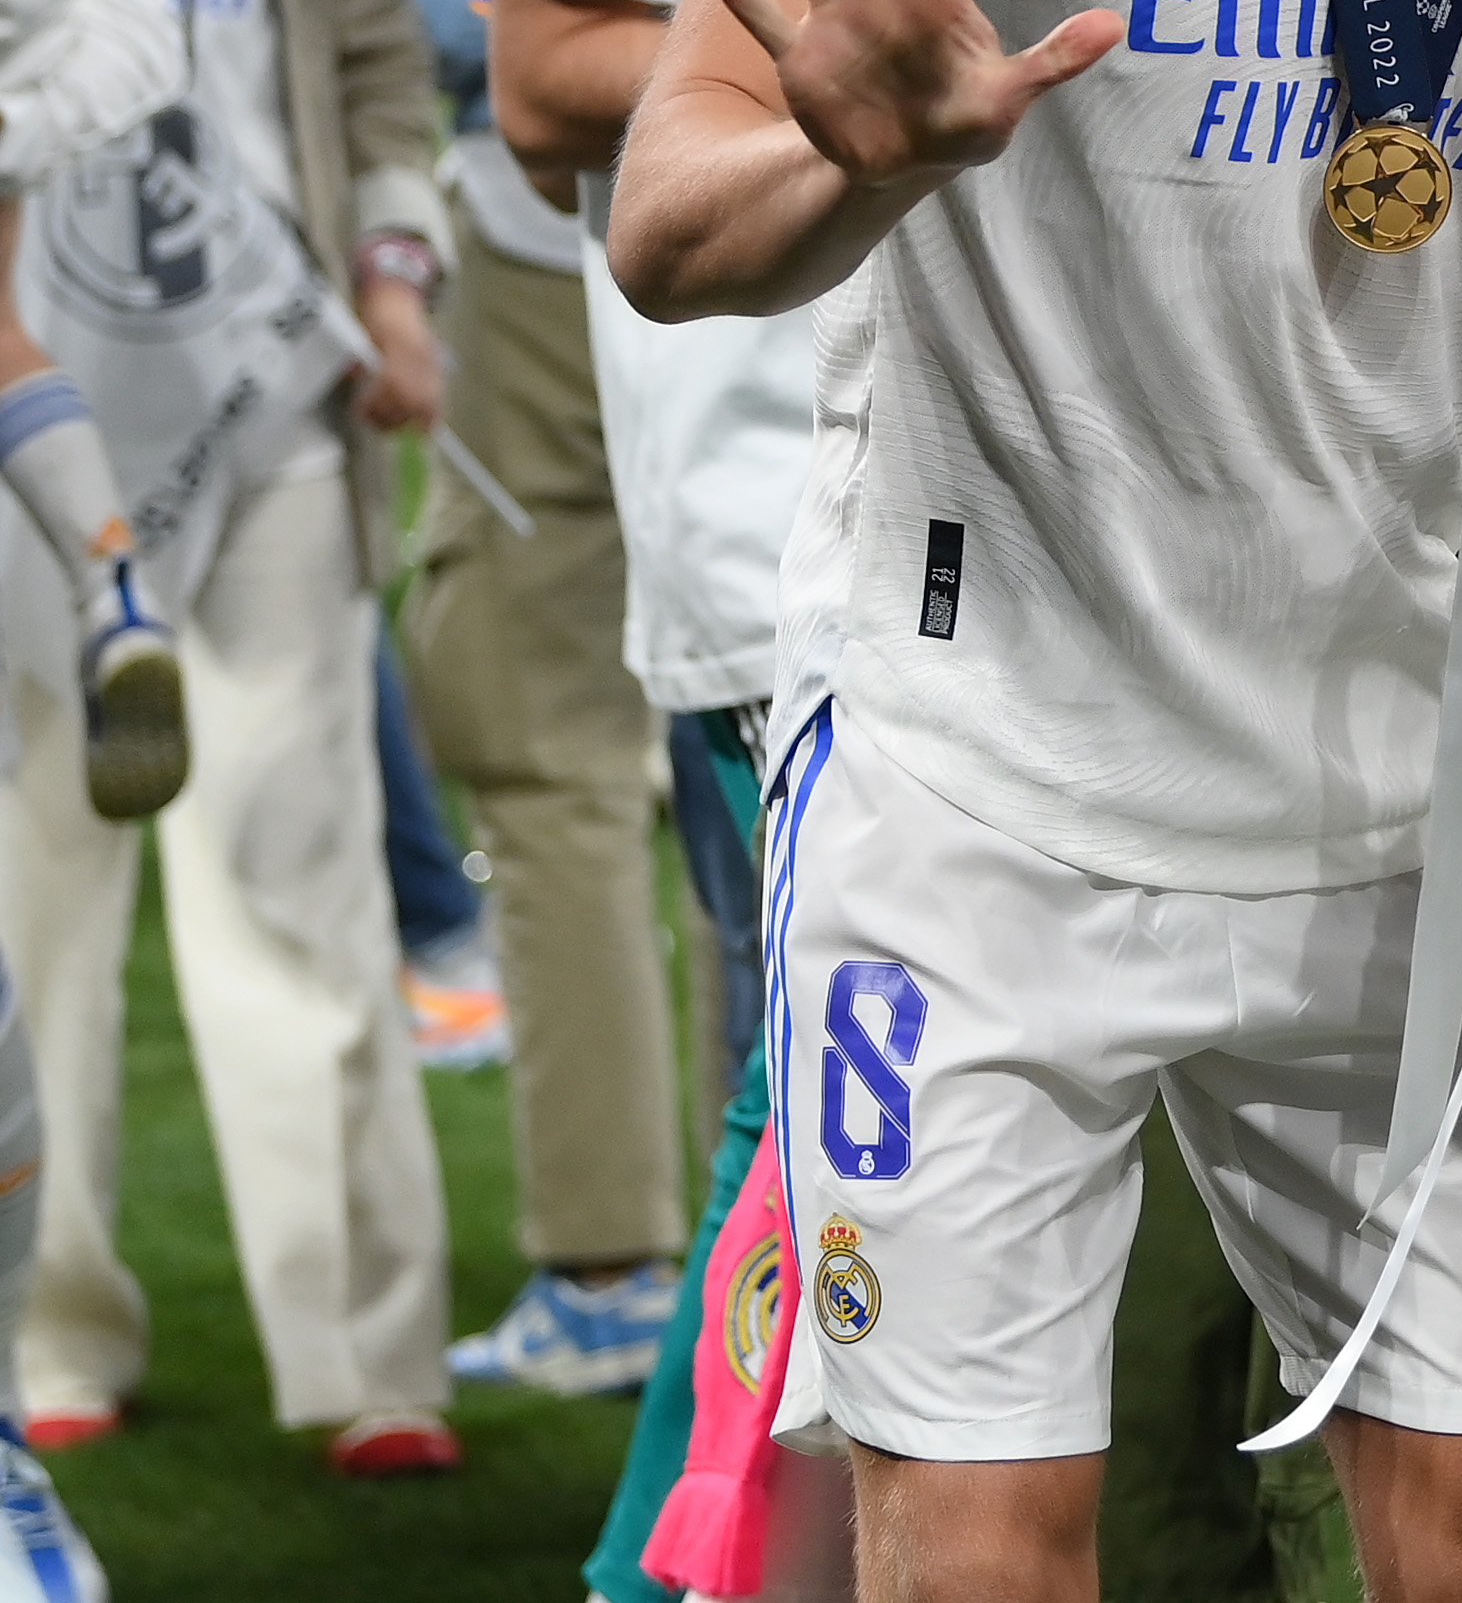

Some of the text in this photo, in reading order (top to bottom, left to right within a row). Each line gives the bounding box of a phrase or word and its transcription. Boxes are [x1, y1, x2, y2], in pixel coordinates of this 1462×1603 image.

[1366, 20, 1400, 89] 2022
[1190, 80, 1299, 164] FLY
[819, 960, 928, 1180] 8
